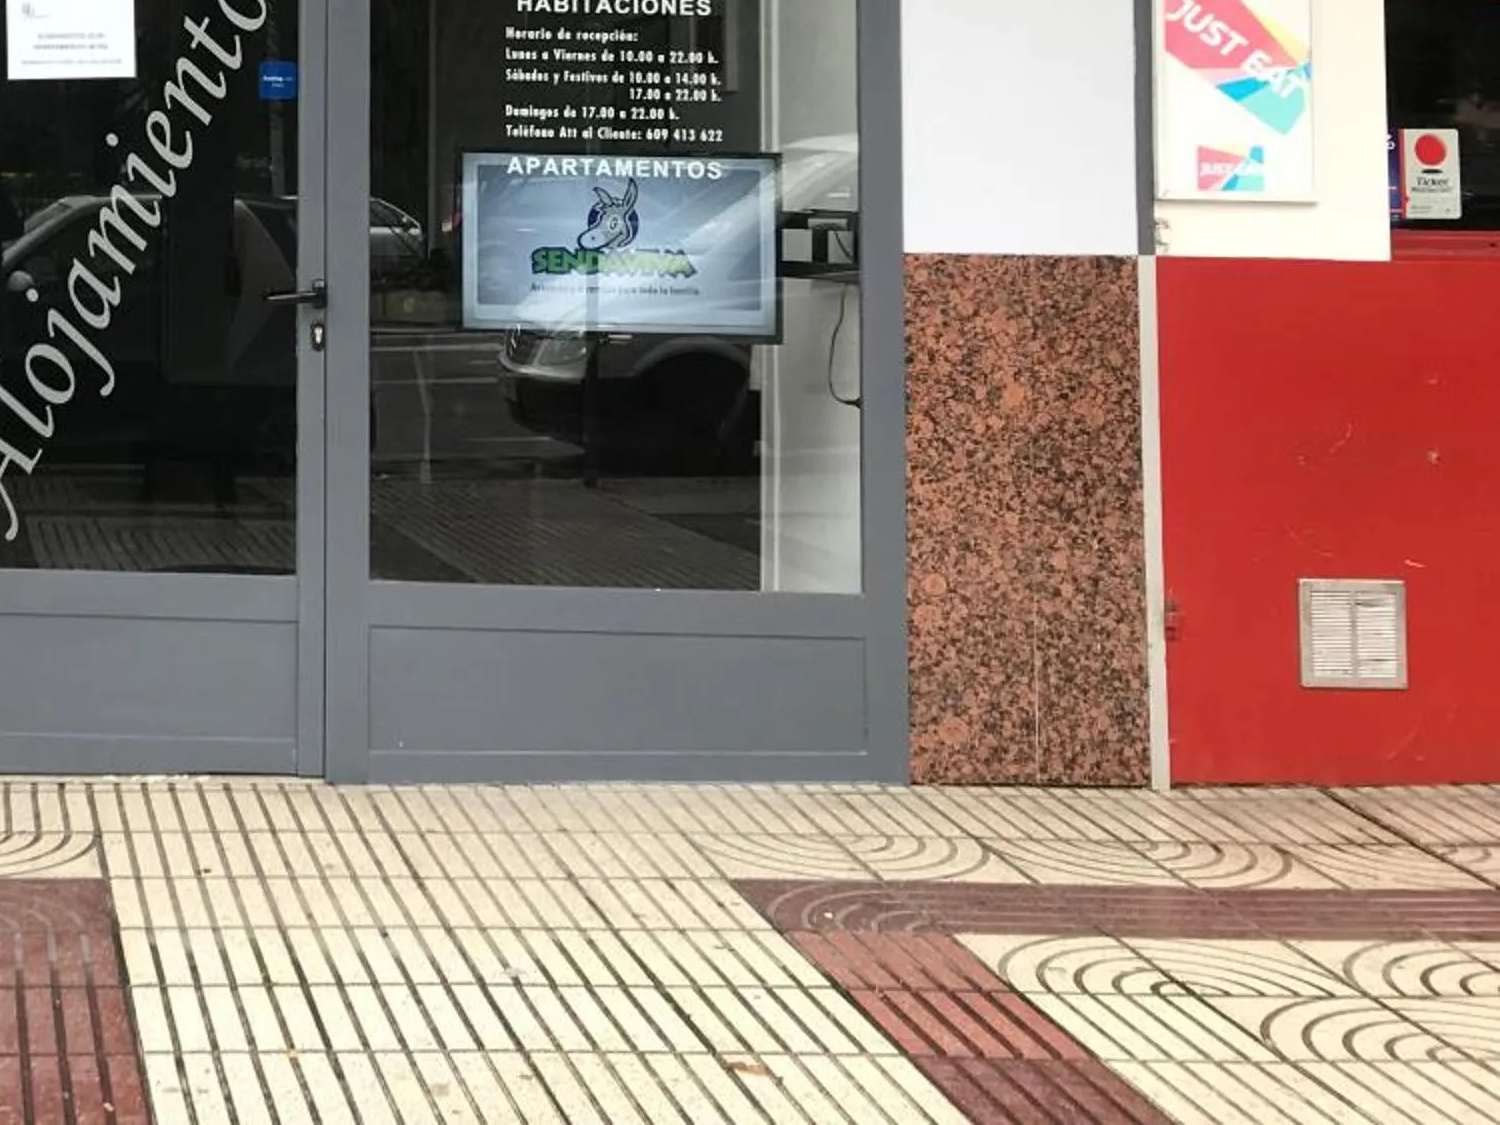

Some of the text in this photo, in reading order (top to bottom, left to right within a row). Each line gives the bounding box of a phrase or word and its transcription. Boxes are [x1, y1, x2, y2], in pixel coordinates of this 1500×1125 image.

[505, 26, 552, 40] Horario
[557, 27, 571, 40] de
[505, 47, 537, 60] Lunes
[541, 51, 549, 60] a
[553, 48, 597, 61] Viernes
[601, 48, 615, 62] de
[620, 50, 654, 63] 10.00
[669, 50, 703, 64] 22.00
[553, 73, 560, 86] y
[564, 70, 608, 83] Festivos
[612, 70, 624, 84] de
[629, 71, 660, 84] 10.00
[664, 76, 671, 84] a
[675, 72, 707, 85] 14.00
[1240, 48, 1308, 98] EAT
[629, 88, 661, 100] 17.00
[664, 92, 671, 101] a
[675, 88, 707, 102] 22.00
[505, 104, 559, 120] Domingos
[563, 104, 577, 118] de
[581, 106, 615, 119] 17.00
[619, 110, 627, 119] a
[630, 107, 665, 120] 22.00
[582, 125, 593, 139] al
[646, 128, 669, 140] 609
[673, 128, 696, 142] 413
[700, 128, 723, 142] 622
[507, 156, 723, 180] APARTAMENTOS
